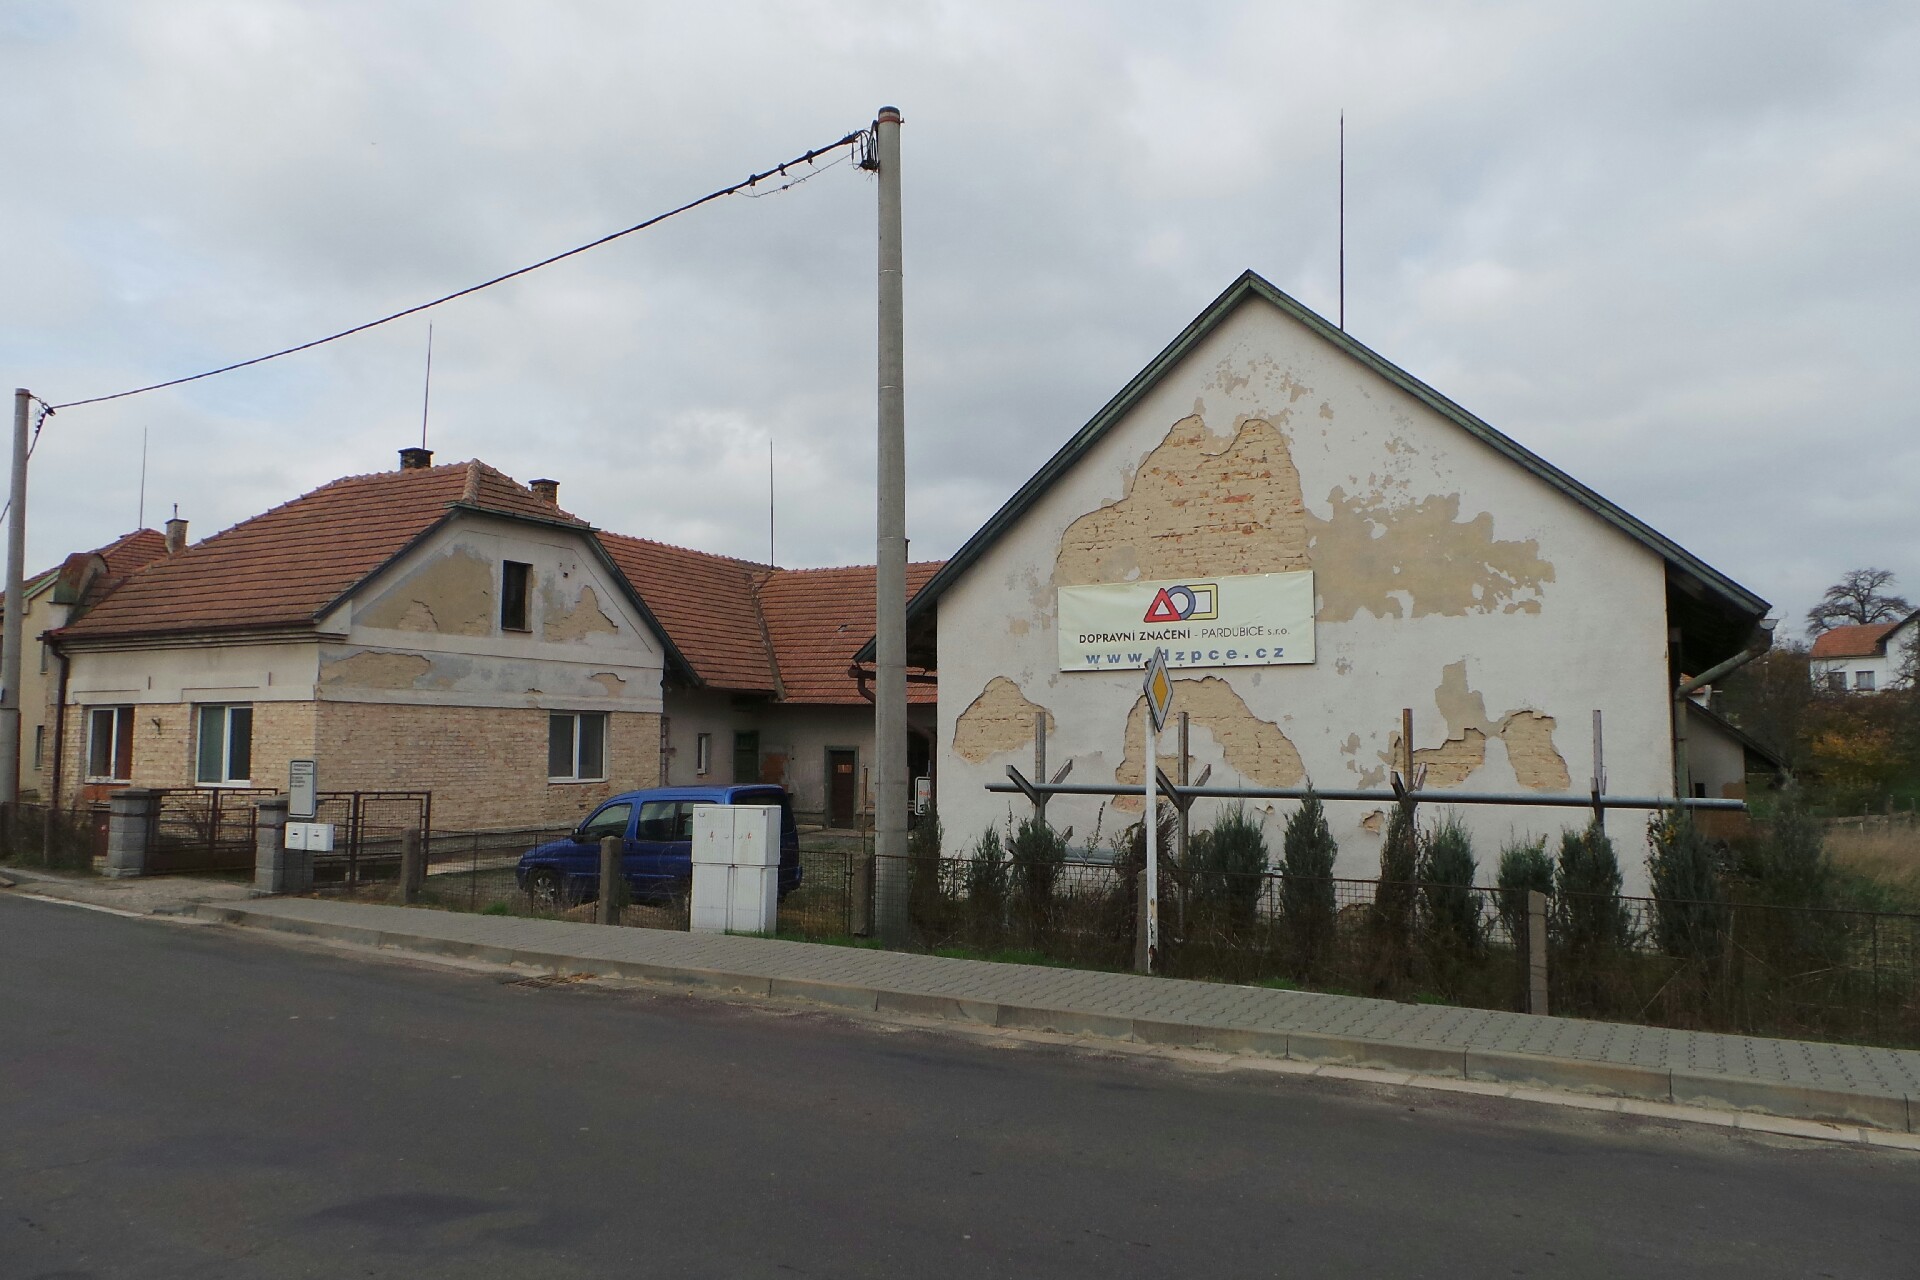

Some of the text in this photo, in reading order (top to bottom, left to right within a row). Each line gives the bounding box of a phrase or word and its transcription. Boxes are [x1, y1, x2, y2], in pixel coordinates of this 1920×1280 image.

[1079, 630, 1135, 644] DOPRAVNÍ
[1139, 628, 1191, 641] ZNAČENÍ
[1201, 626, 1264, 639] PARDUBICE
